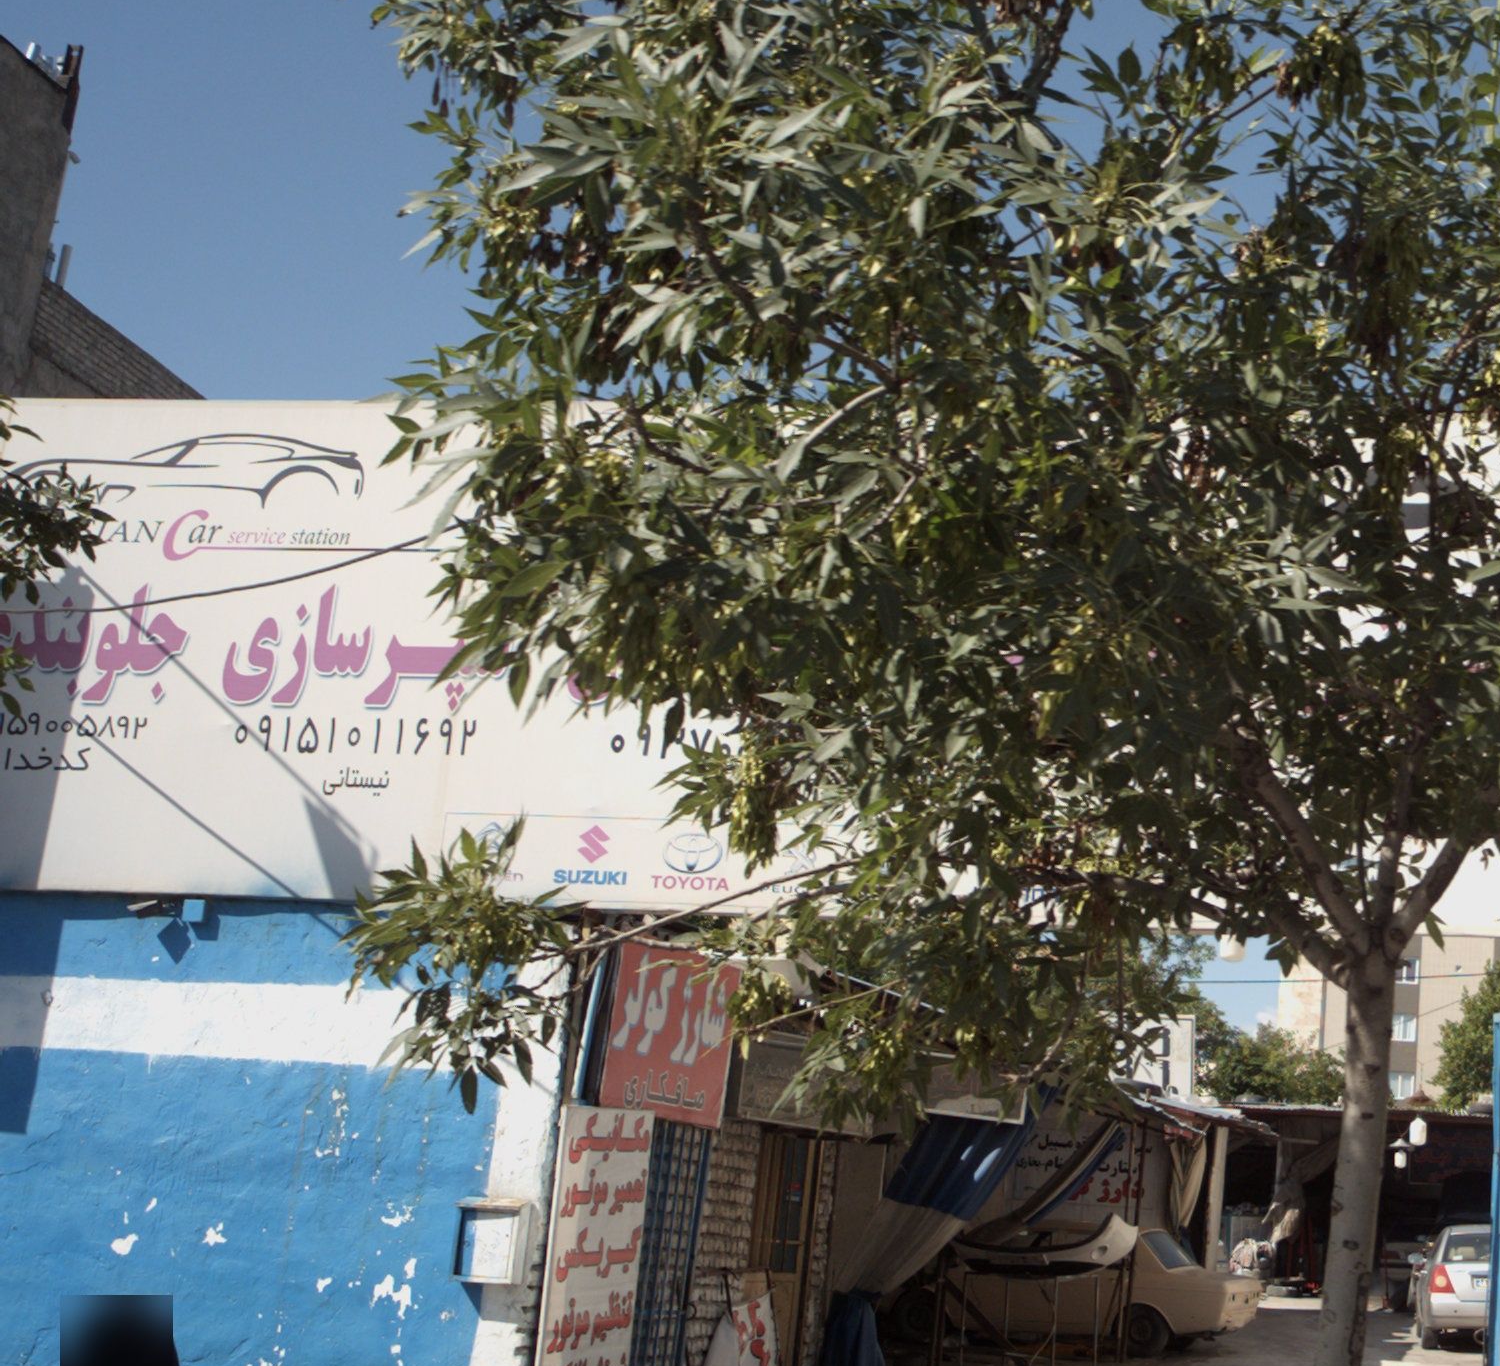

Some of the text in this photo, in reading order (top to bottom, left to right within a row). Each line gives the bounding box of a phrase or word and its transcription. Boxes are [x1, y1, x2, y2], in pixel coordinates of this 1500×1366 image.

[162, 509, 223, 561] Car
[227, 527, 287, 545] service
[290, 526, 351, 546] station
[0, 583, 189, 704] جلوبند
[222, 583, 508, 712] پرسازی
[553, 868, 628, 886] SUZUKI
[651, 874, 730, 892] TOYOTA
[612, 952, 678, 1056] کولر
[568, 1112, 650, 1163] مکانیکی
[560, 1168, 648, 1218] تعمیر موتور
[546, 1289, 634, 1355] تنظیم موتور
